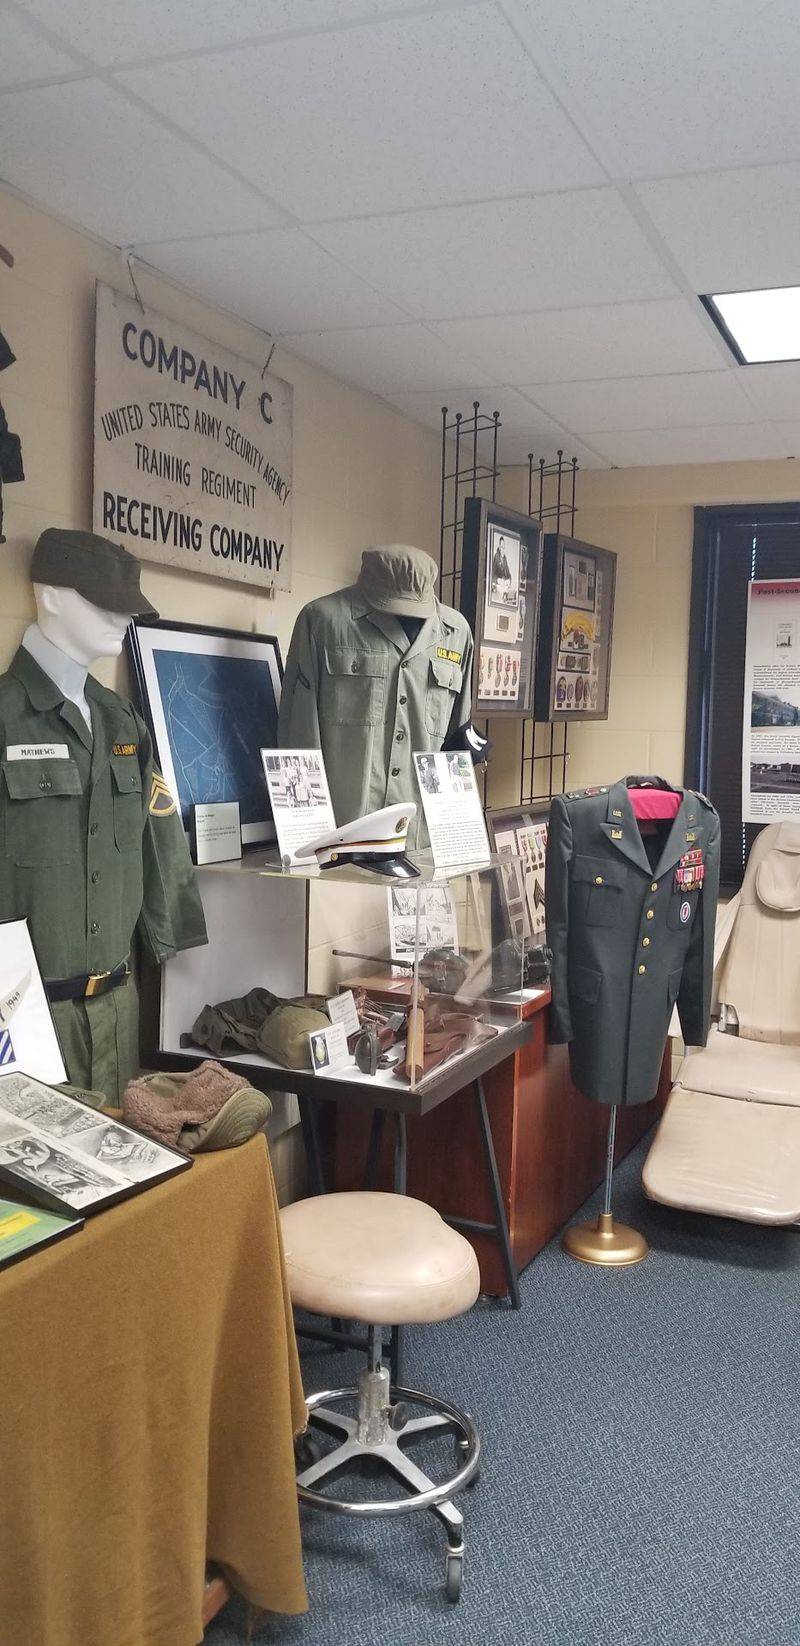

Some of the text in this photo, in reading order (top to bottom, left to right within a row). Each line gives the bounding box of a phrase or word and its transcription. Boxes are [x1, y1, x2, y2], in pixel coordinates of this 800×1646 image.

[122, 321, 273, 424] COMPANY C
[101, 402, 291, 507] UNITED STATES ARMY SECURITY AGENCY
[135, 442, 257, 509] TRAINING REGIMENT
[103, 491, 285, 572] RECEIVING COMPANY
[448, 651, 461, 664] ARMY
[21, 748, 55, 756] MATHEWS
[121, 744, 137, 755] ARMY
